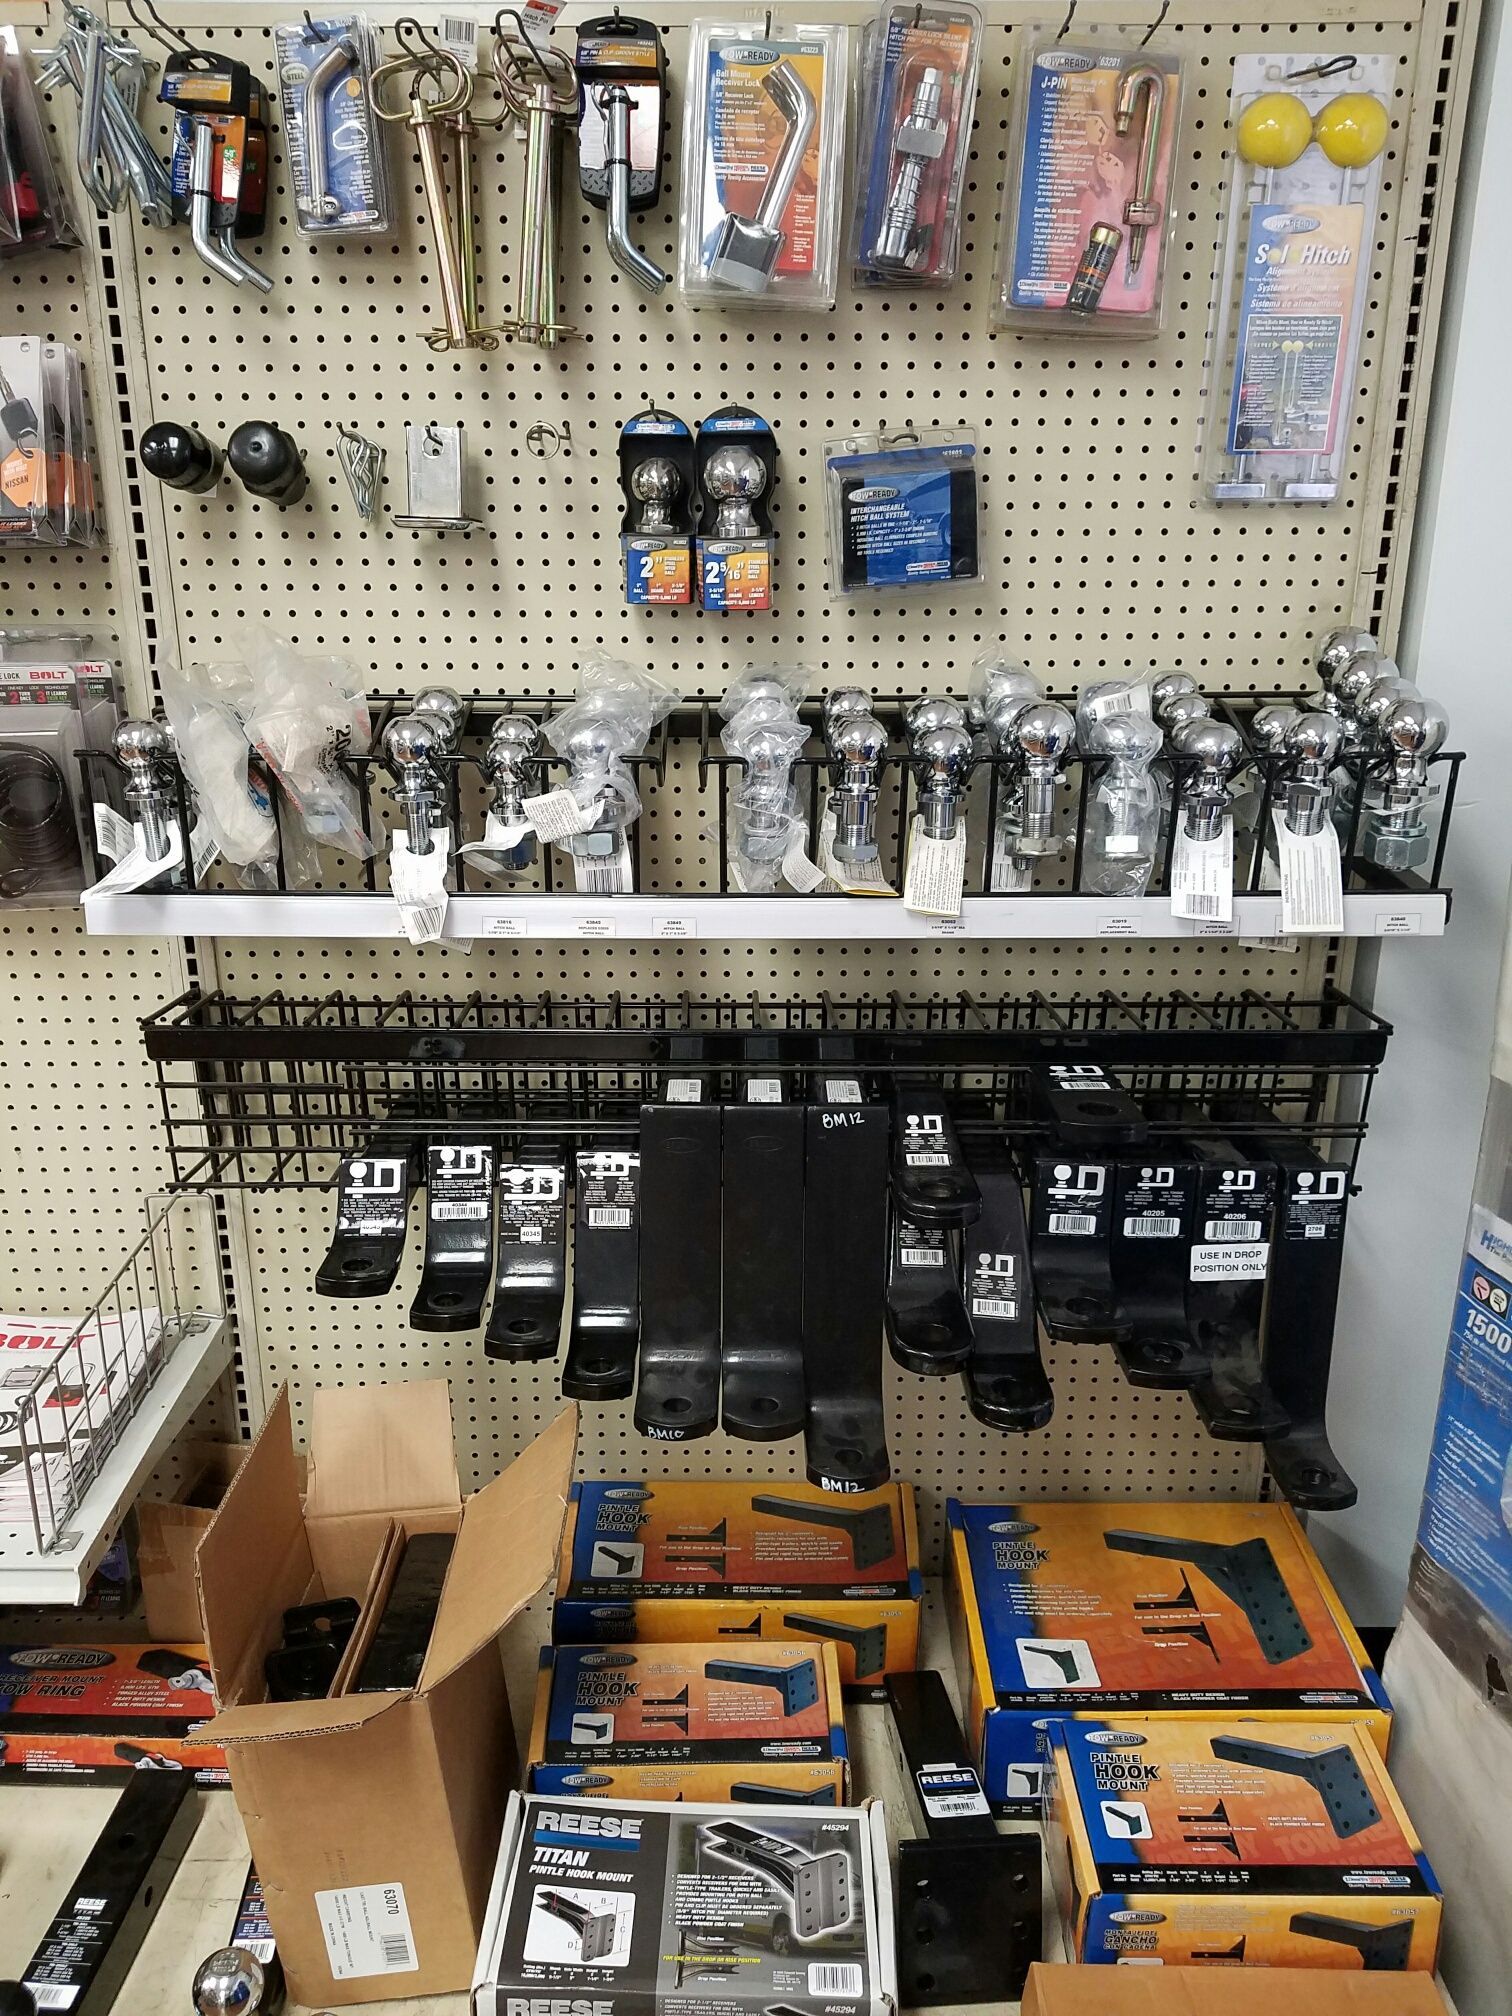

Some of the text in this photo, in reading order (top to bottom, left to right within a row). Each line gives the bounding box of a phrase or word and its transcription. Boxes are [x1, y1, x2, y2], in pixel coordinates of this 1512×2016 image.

[523, 12, 539, 21] Hitch
[748, 51, 774, 61] READY
[1064, 58, 1091, 68] READY
[286, 73, 304, 81] STEEL
[716, 69, 729, 77] Ball
[715, 78, 761, 87] Receiver Lock
[1040, 75, 1068, 89] J-PIN
[1301, 243, 1352, 265] Hitch
[1250, 298, 1281, 308] Sistema
[4, 475, 29, 489] NISSAN
[872, 489, 895, 499] READY
[850, 502, 906, 515] INTERCHANGEABLE
[850, 510, 910, 523] HITCH BALL SYSTEM
[640, 556, 663, 578] 2"
[4, 671, 68, 680] LOCK BOLT
[9, 690, 19, 705] 2
[36, 689, 47, 703] 3
[1199, 1250, 1262, 1260] USE IN DROP
[1193, 1263, 1267, 1273] POSITION ONLY
[1466, 1309, 1512, 1354] 1500
[598, 1503, 640, 1512] PINTLE
[597, 1512, 653, 1525] HOOK
[595, 1523, 639, 1532] MOUNT
[992, 1541, 1035, 1550] PINTLE
[995, 1549, 1050, 1562] HOOK
[996, 1562, 1040, 1570] MOUNT
[16, 1653, 106, 1665] TOW READY
[582, 1655, 632, 1664] TOW READY
[0, 1673, 105, 1684] RECEIVER MOUNT
[577, 1671, 627, 1682] PINTLE
[35, 1683, 87, 1697] RING
[577, 1681, 641, 1696] HOOK
[575, 1697, 625, 1706] MOUNT
[1113, 1735, 1140, 1743] READY
[1089, 1752, 1141, 1763] PINTLE
[1094, 1764, 1161, 1780] HOOK
[567, 1776, 583, 1784] TOW
[921, 1773, 974, 1784] REESE
[1096, 1780, 1149, 1791] MOUNT
[537, 1810, 643, 1840] REESE
[821, 1824, 850, 1832] #45294
[533, 1846, 590, 1867] TITAN
[528, 1864, 634, 1883] PINTLE HOOK MOUNT
[572, 1892, 579, 1900] A
[383, 1889, 400, 1915] 63070
[567, 1941, 574, 1949] D
[1103, 1935, 1158, 1945] GANCHO
[506, 1997, 615, 2016] REESE
[824, 2005, 857, 2014] #45294
